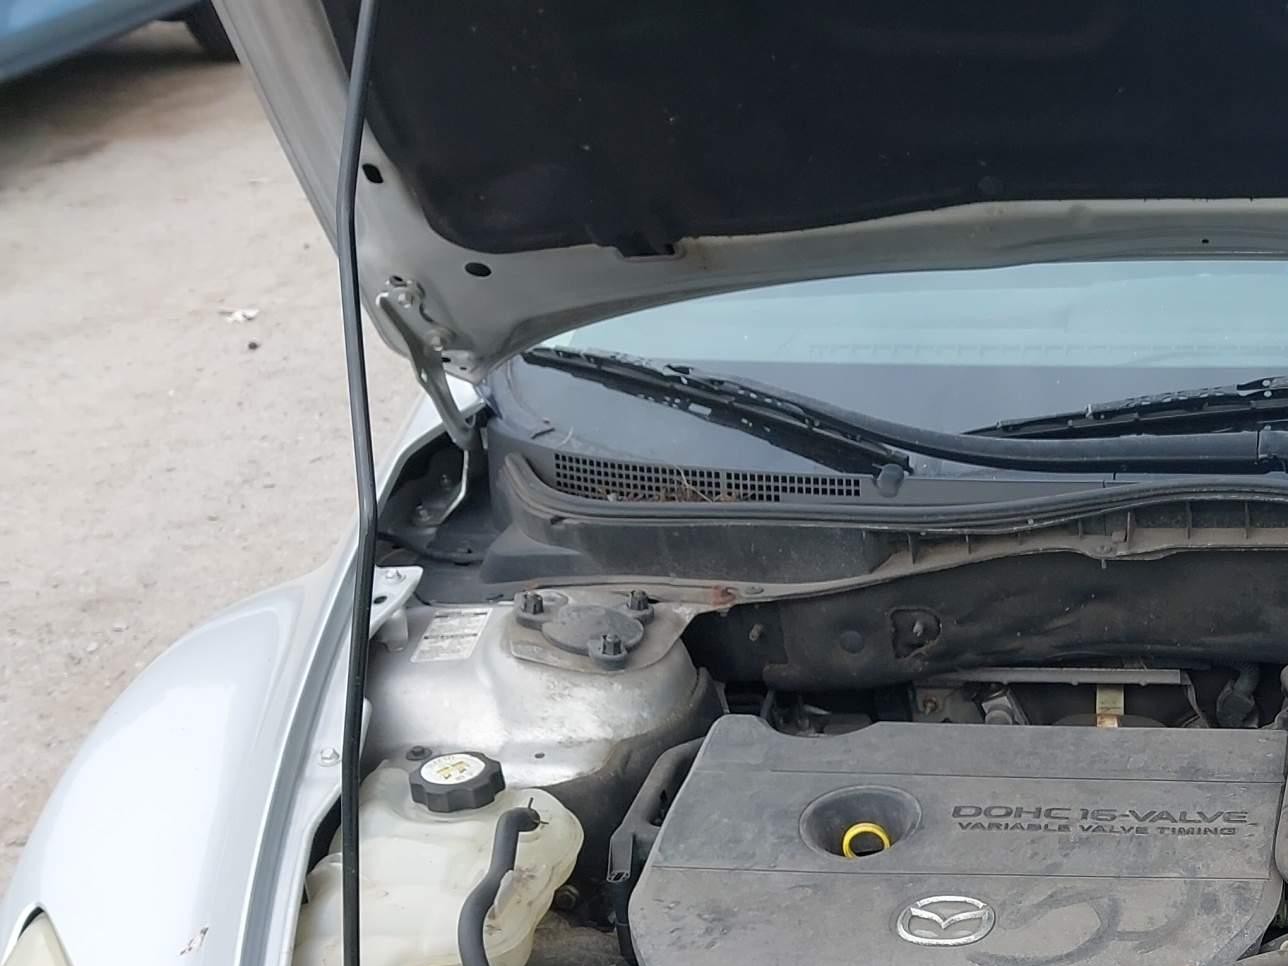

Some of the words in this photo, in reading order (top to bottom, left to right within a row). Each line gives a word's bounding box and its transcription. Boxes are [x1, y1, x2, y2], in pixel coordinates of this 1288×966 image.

[952, 805, 1071, 820] DOHC
[1080, 808, 1249, 824] 16-VALVE
[958, 822, 1071, 832] VARIABLE
[1079, 824, 1149, 835] VALVE
[1156, 826, 1237, 836] TIMING
